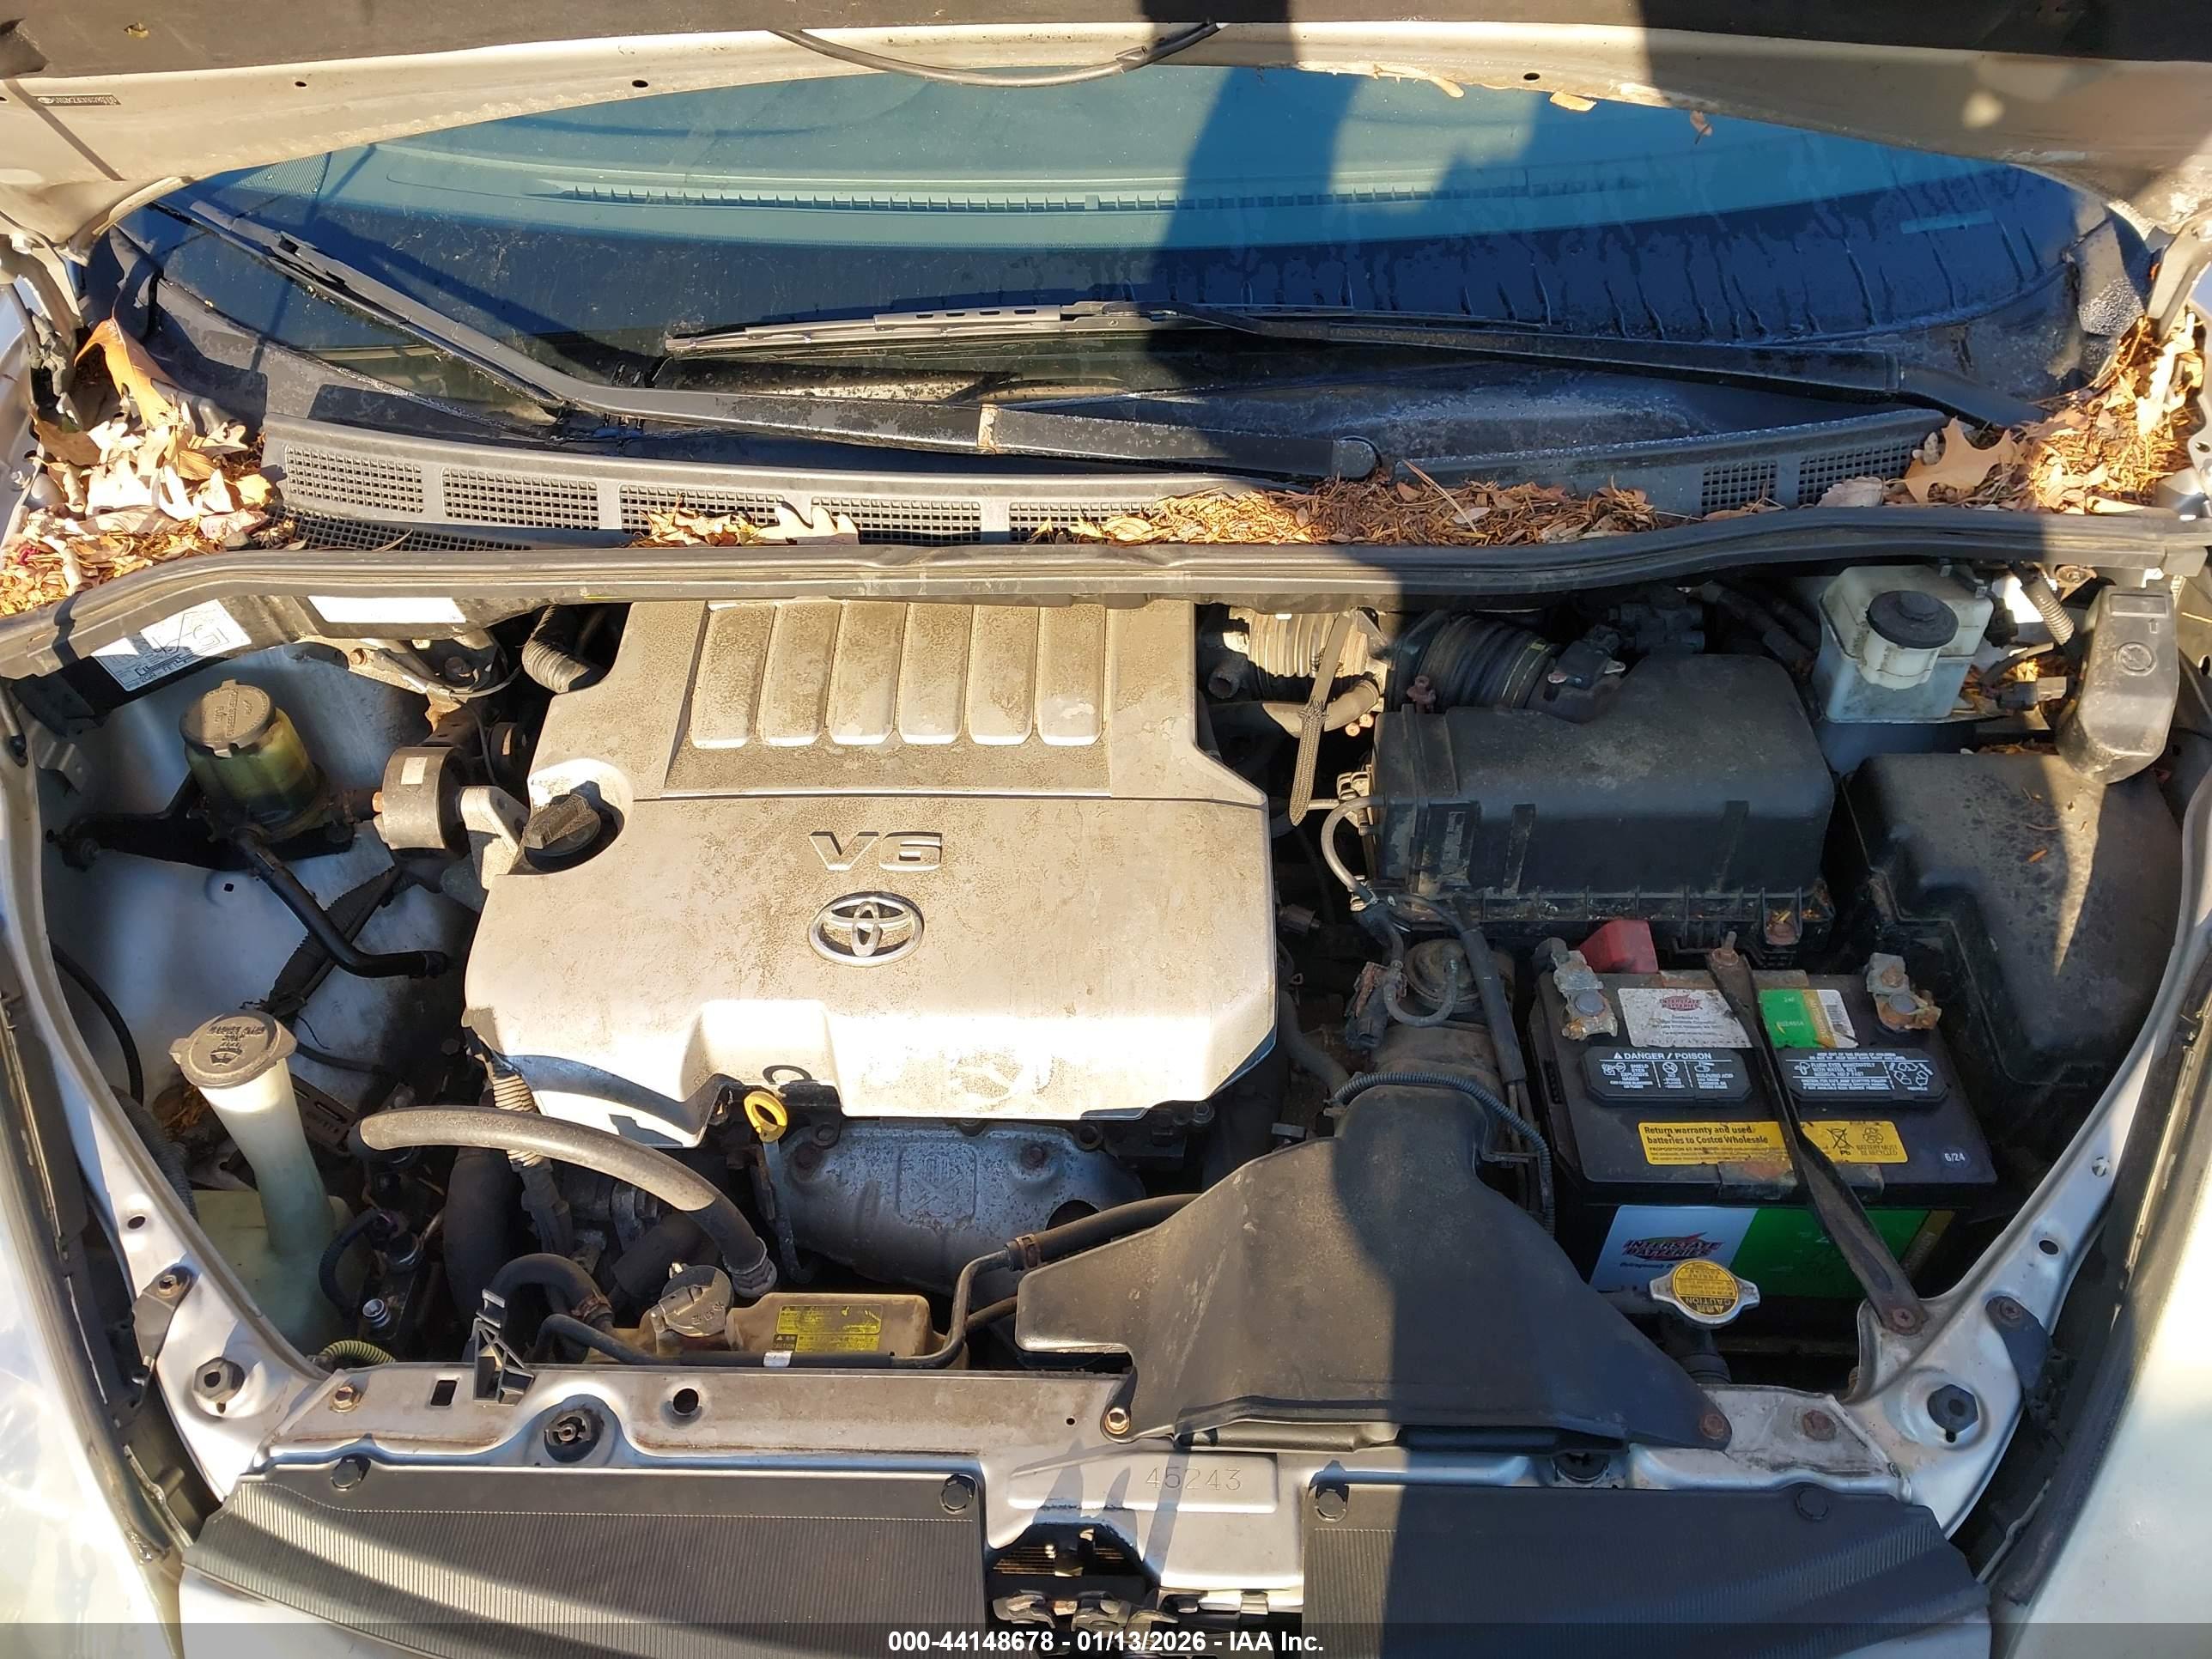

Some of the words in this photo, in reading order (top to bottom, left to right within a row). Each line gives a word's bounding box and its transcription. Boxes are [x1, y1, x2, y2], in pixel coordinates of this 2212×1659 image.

[810, 831, 943, 872] V6
[1644, 1127, 1674, 1135] Return
[1724, 1135, 1768, 1144] Wholesale
[1944, 1152, 1966, 1162] 6/24
[1622, 1239, 1723, 1249] INTERSTATE
[1686, 1297, 1731, 1306] CAUTION
[1146, 1467, 1241, 1491] 45243
